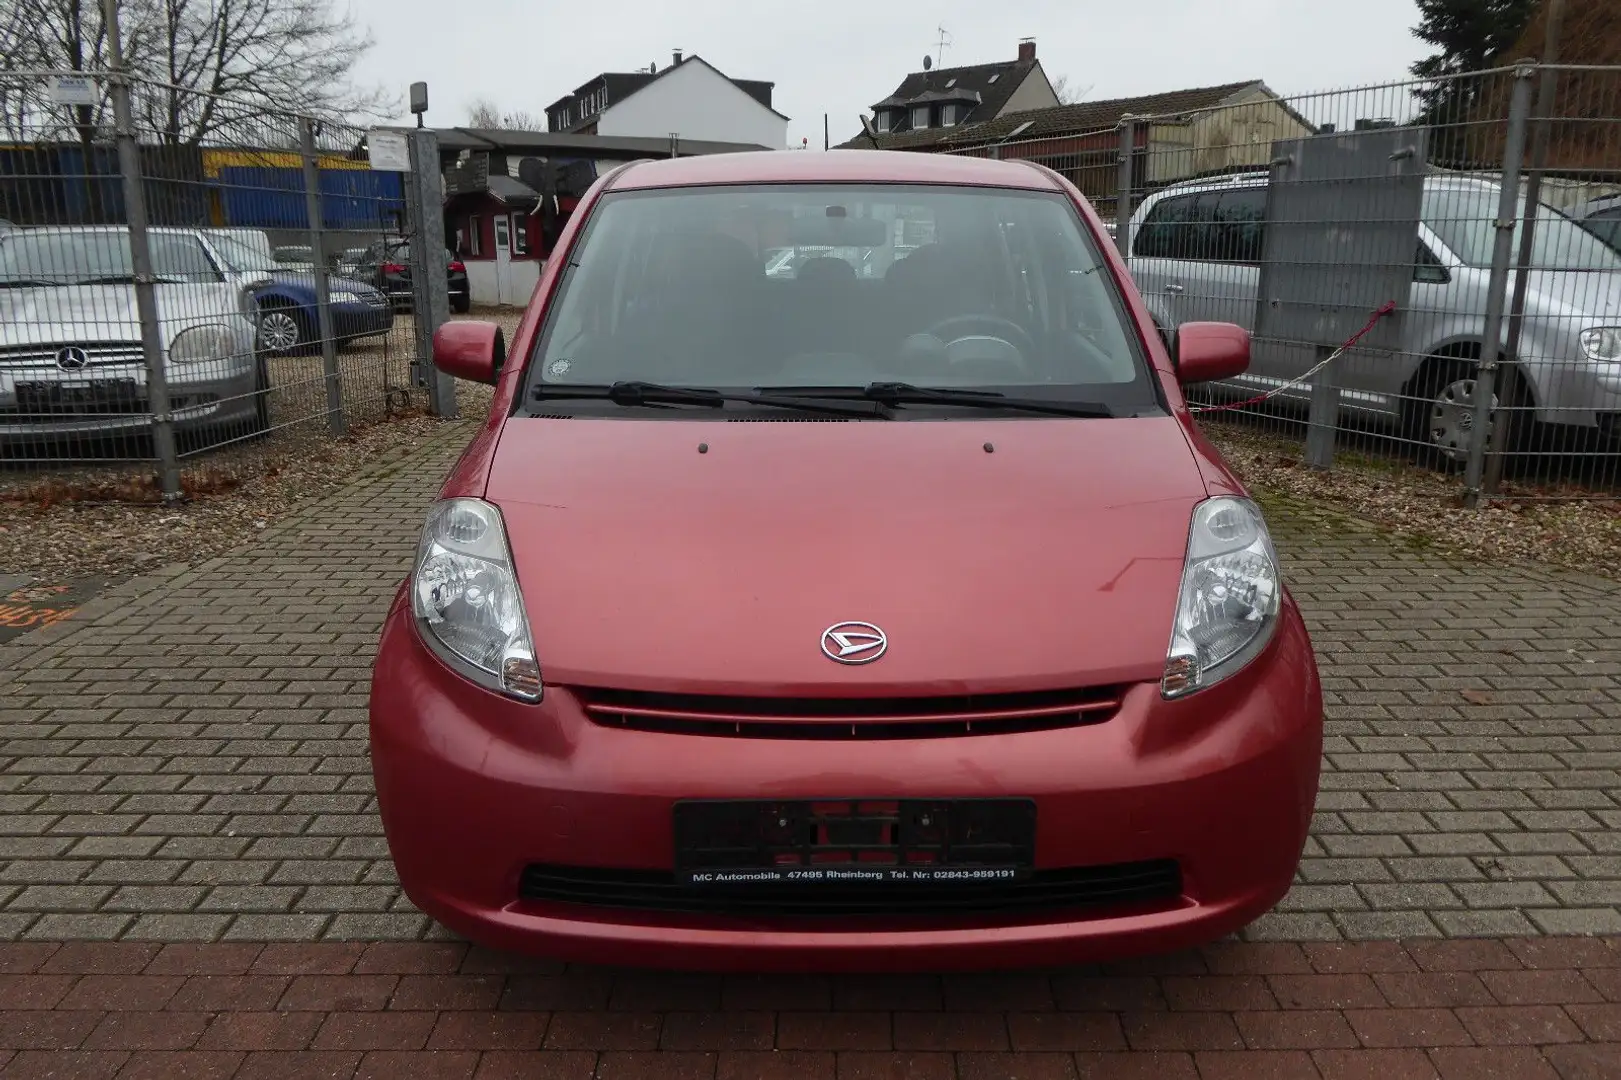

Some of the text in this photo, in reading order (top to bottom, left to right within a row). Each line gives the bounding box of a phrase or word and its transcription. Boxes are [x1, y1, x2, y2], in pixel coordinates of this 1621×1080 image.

[692, 869, 1015, 882] MC Automobile 47495 Rheinberg Tel. Nr: 02843-959191
